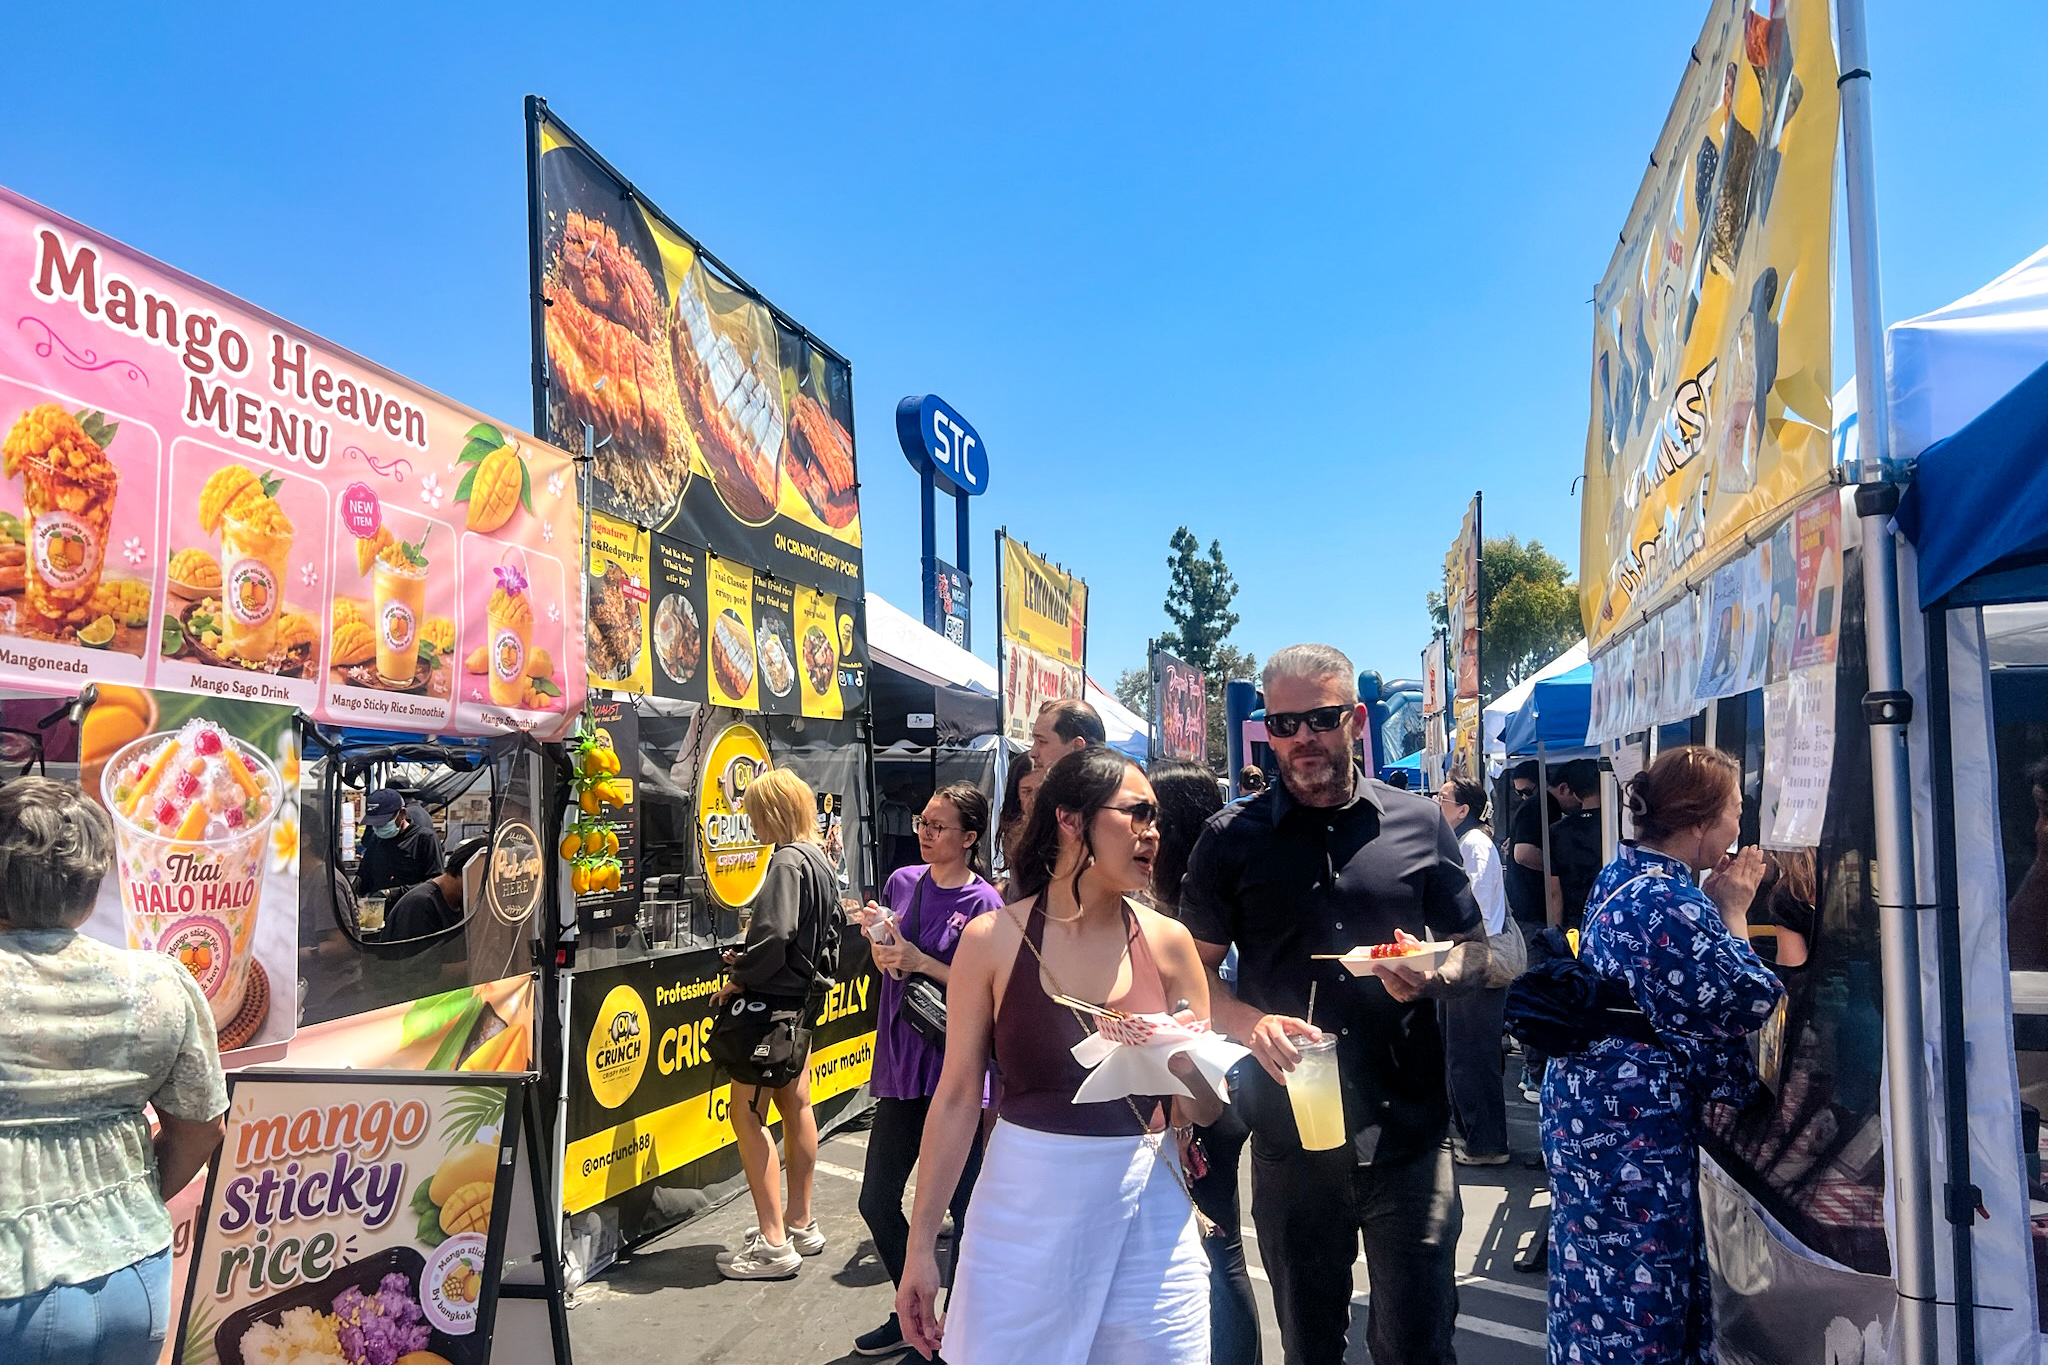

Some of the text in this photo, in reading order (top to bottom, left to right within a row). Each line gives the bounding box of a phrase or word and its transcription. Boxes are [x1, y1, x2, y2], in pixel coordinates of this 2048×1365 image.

[36, 230, 428, 447] Mango Heaven
[186, 376, 330, 465] MENU
[932, 409, 977, 486] STC
[349, 497, 375, 517] NEW
[352, 514, 374, 528] ITEM
[590, 539, 645, 563] c&Redpepper
[774, 532, 859, 579] ON CRUNCH CRISPY PORK
[714, 569, 748, 591] Thai Classic
[754, 575, 793, 597] Thai fried rice
[715, 588, 747, 606] crispy pork
[766, 594, 780, 608] fried
[1023, 567, 1071, 628] LEMONADE
[0, 649, 89, 675] Mangoneada
[190, 674, 290, 700] Mango Sago Drink
[332, 693, 446, 719] Mango Sticky Rice Smoothie
[480, 712, 538, 730] Mango Smoothie
[706, 813, 761, 848] CRUNC
[166, 853, 223, 884] Thai
[131, 878, 255, 914] HALO HALO
[502, 879, 529, 898] HERE
[168, 928, 220, 957] Mango sticky rice
[655, 972, 721, 1007] Professional
[596, 1040, 641, 1070] CRUNCH
[657, 1015, 719, 1076] CRIS
[602, 1068, 618, 1080] CRISPY
[815, 1059, 838, 1087] your
[840, 1042, 871, 1069] mouth
[236, 1099, 426, 1164] mango
[581, 1132, 651, 1177] @oncrunch88
[216, 1228, 335, 1295] rice
[438, 1246, 486, 1271] Mango stick
[432, 1287, 440, 1301] By
[437, 1300, 472, 1322] bangkok
